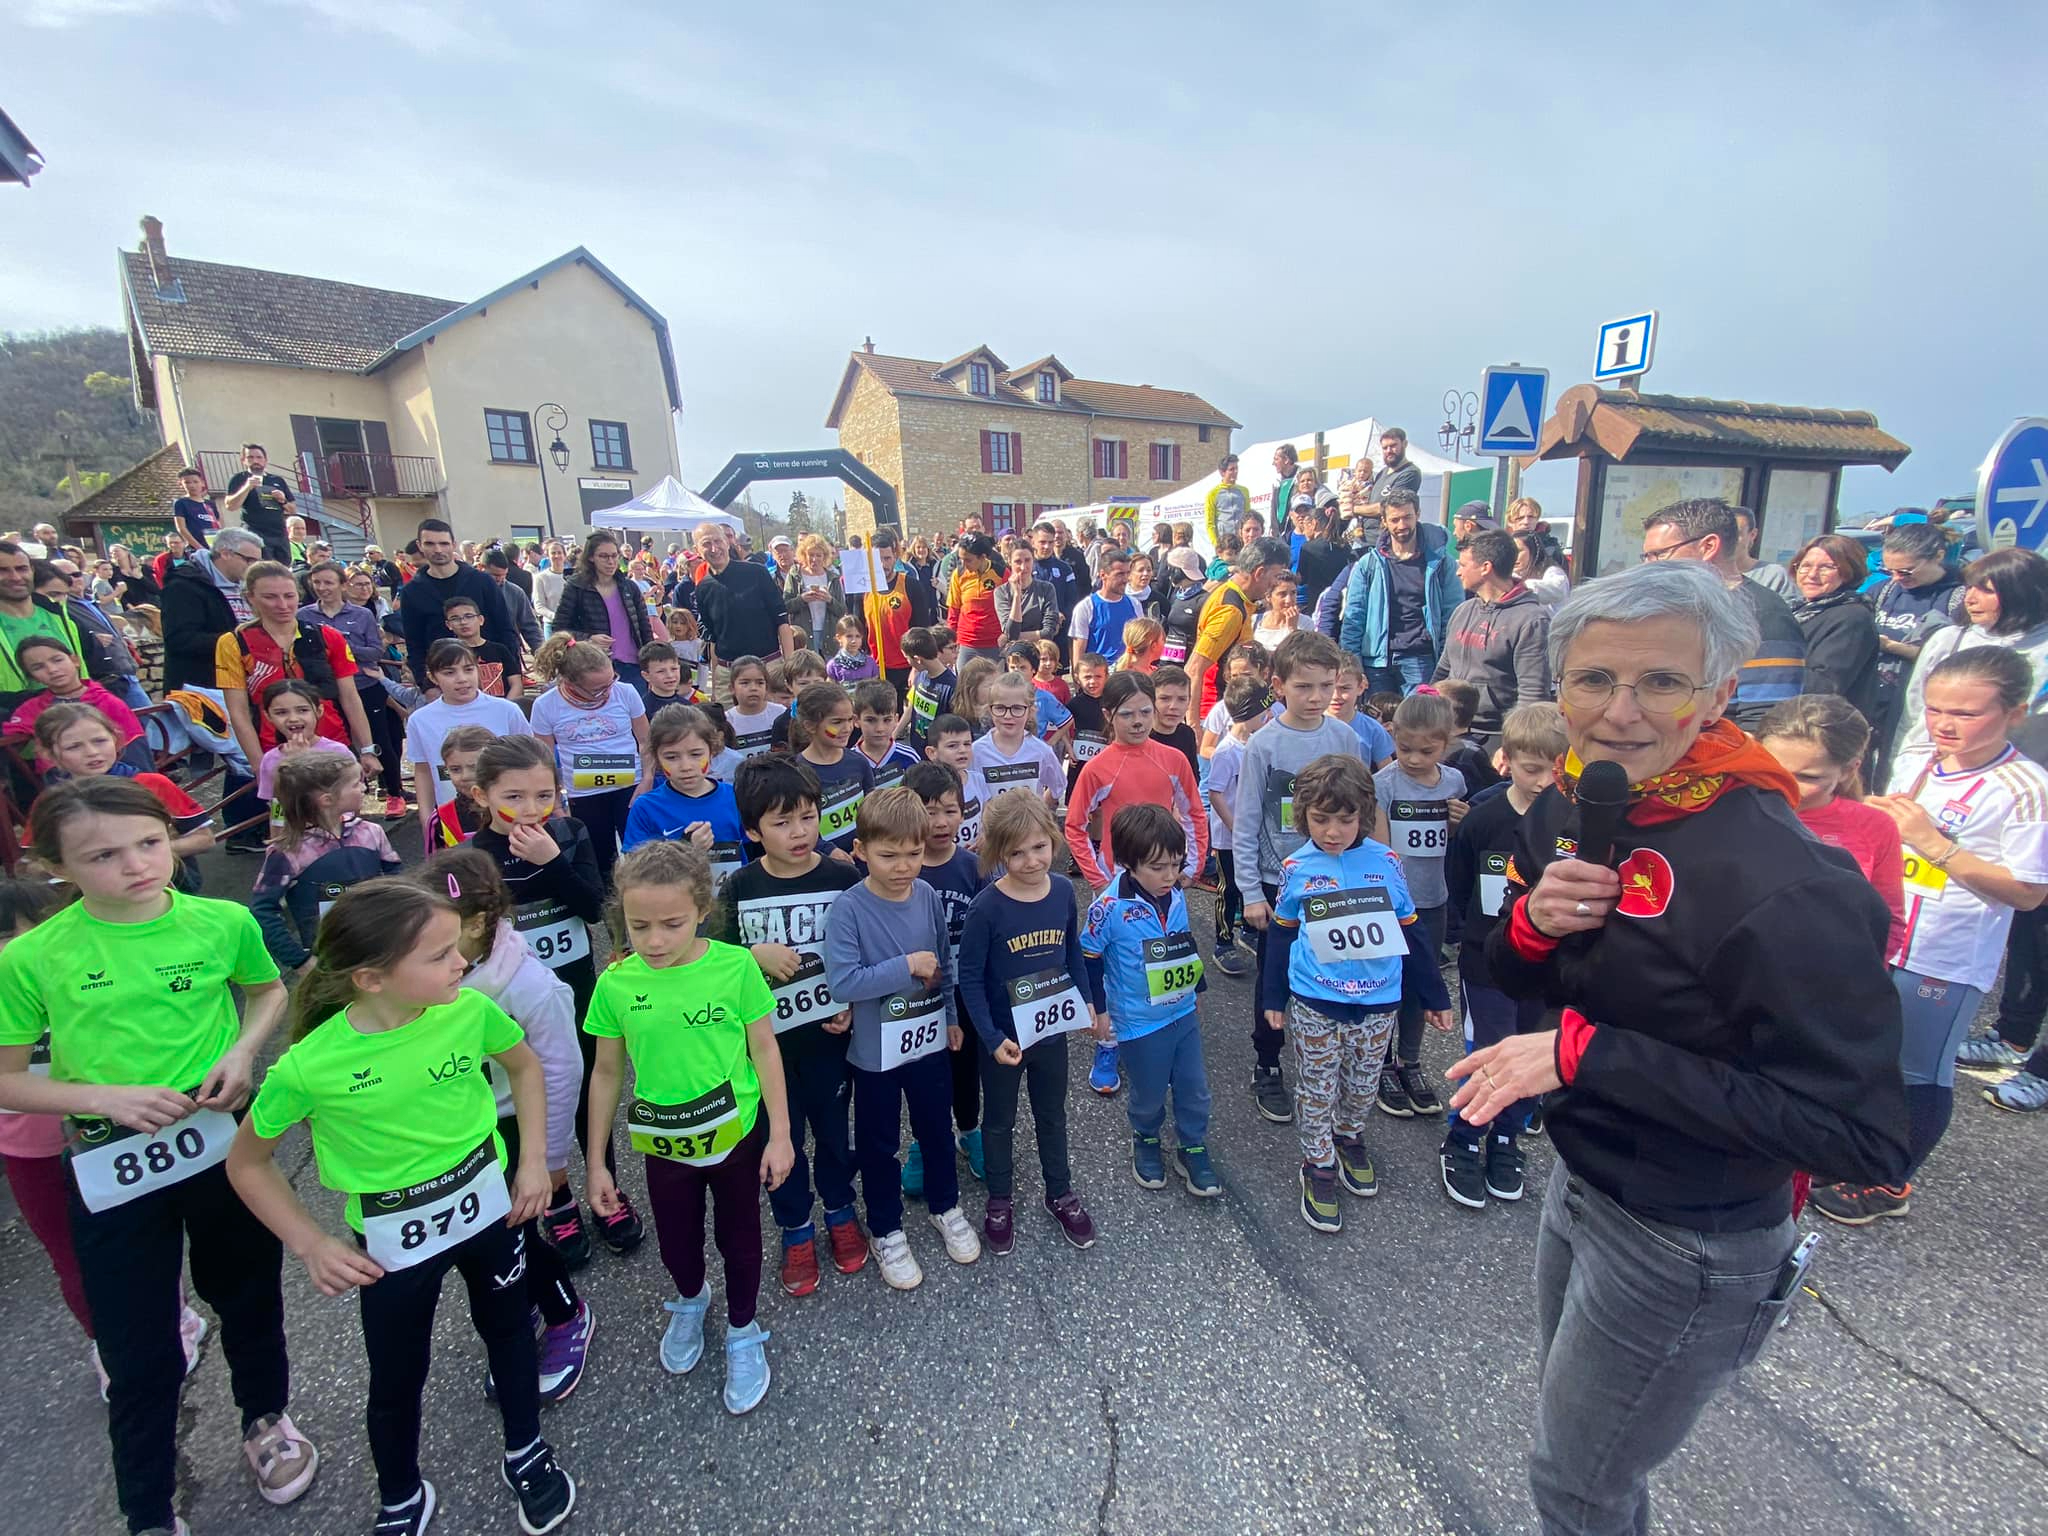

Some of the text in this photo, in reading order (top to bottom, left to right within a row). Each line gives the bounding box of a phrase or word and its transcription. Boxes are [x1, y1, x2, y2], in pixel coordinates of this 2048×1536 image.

[801, 459, 828, 468] running
[594, 774, 616, 787] 85
[1408, 829, 1446, 848] 889
[1328, 898, 1345, 909] terre
[1347, 896, 1356, 905] de
[1358, 894, 1384, 904] running
[517, 911, 537, 922] terre
[539, 908, 549, 917] de
[529, 929, 573, 960] 95
[1007, 928, 1065, 952] IMPATIENTE
[1328, 922, 1385, 950] 900
[1034, 980, 1050, 990] terre
[1051, 976, 1059, 985] de
[1164, 964, 1195, 991] 935
[630, 1003, 652, 1012] erima
[776, 983, 832, 1021] 866
[909, 999, 923, 1009] terre
[1034, 999, 1076, 1033] 886
[900, 1021, 939, 1054] 885
[348, 1076, 382, 1093] erima
[657, 1112, 677, 1121] terre
[679, 1110, 691, 1119] de
[693, 1096, 727, 1116] running
[652, 1129, 718, 1158] 937
[113, 1127, 205, 1186] 880
[408, 1178, 438, 1196] terre
[440, 1172, 455, 1186] de
[456, 1148, 485, 1178] running
[400, 1191, 480, 1250] 879
